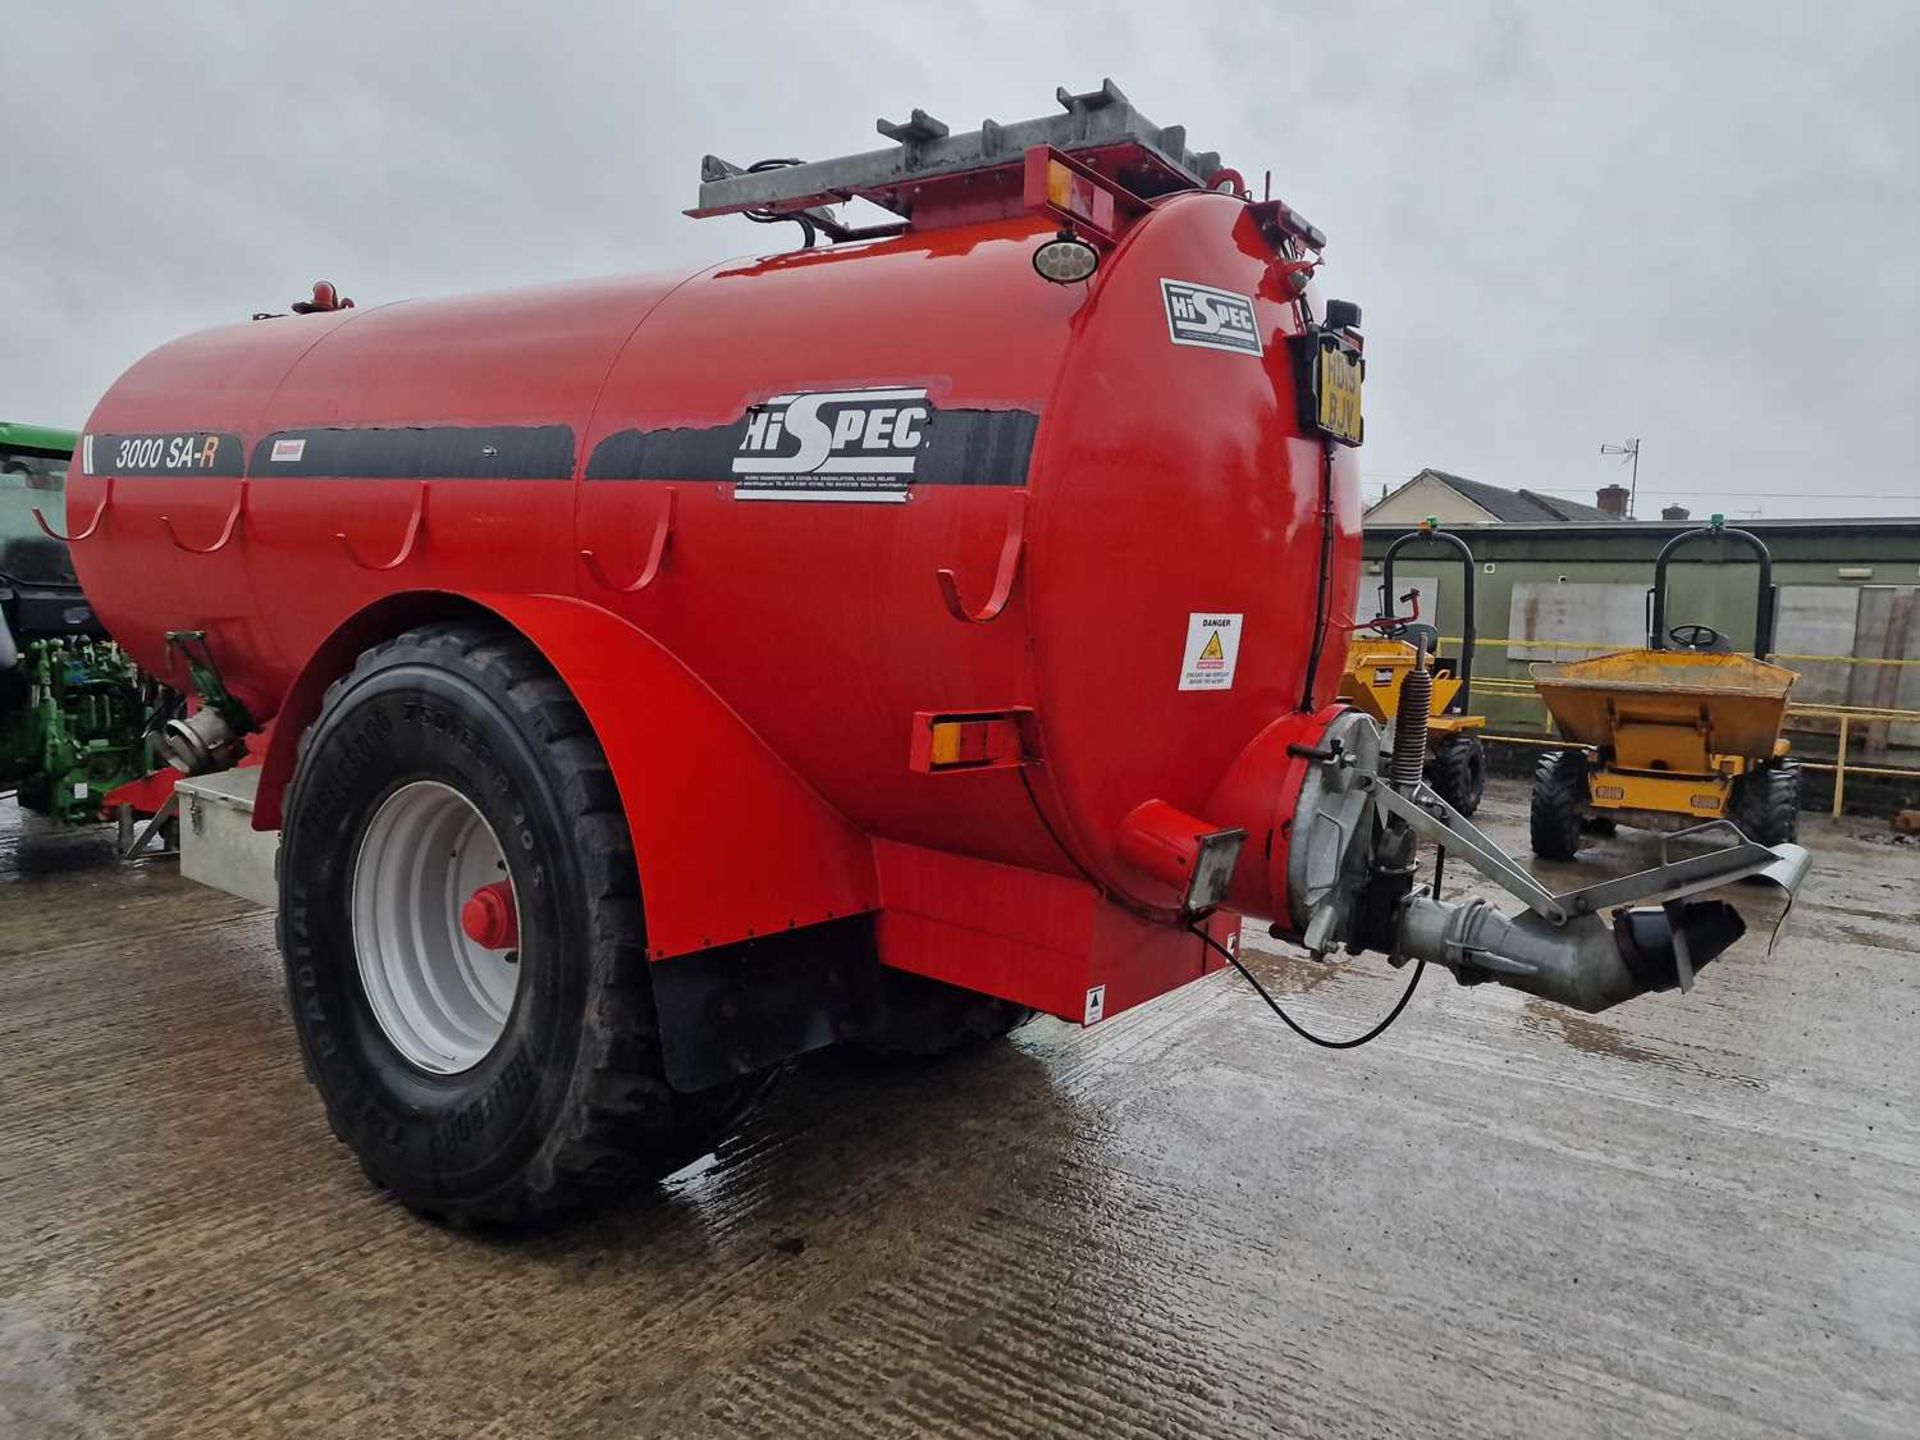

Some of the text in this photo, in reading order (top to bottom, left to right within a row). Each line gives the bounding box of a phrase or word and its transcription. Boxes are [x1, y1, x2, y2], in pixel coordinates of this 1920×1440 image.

[115, 435, 220, 469] 3000 SA-R
[1202, 619, 1231, 627] DANGER
